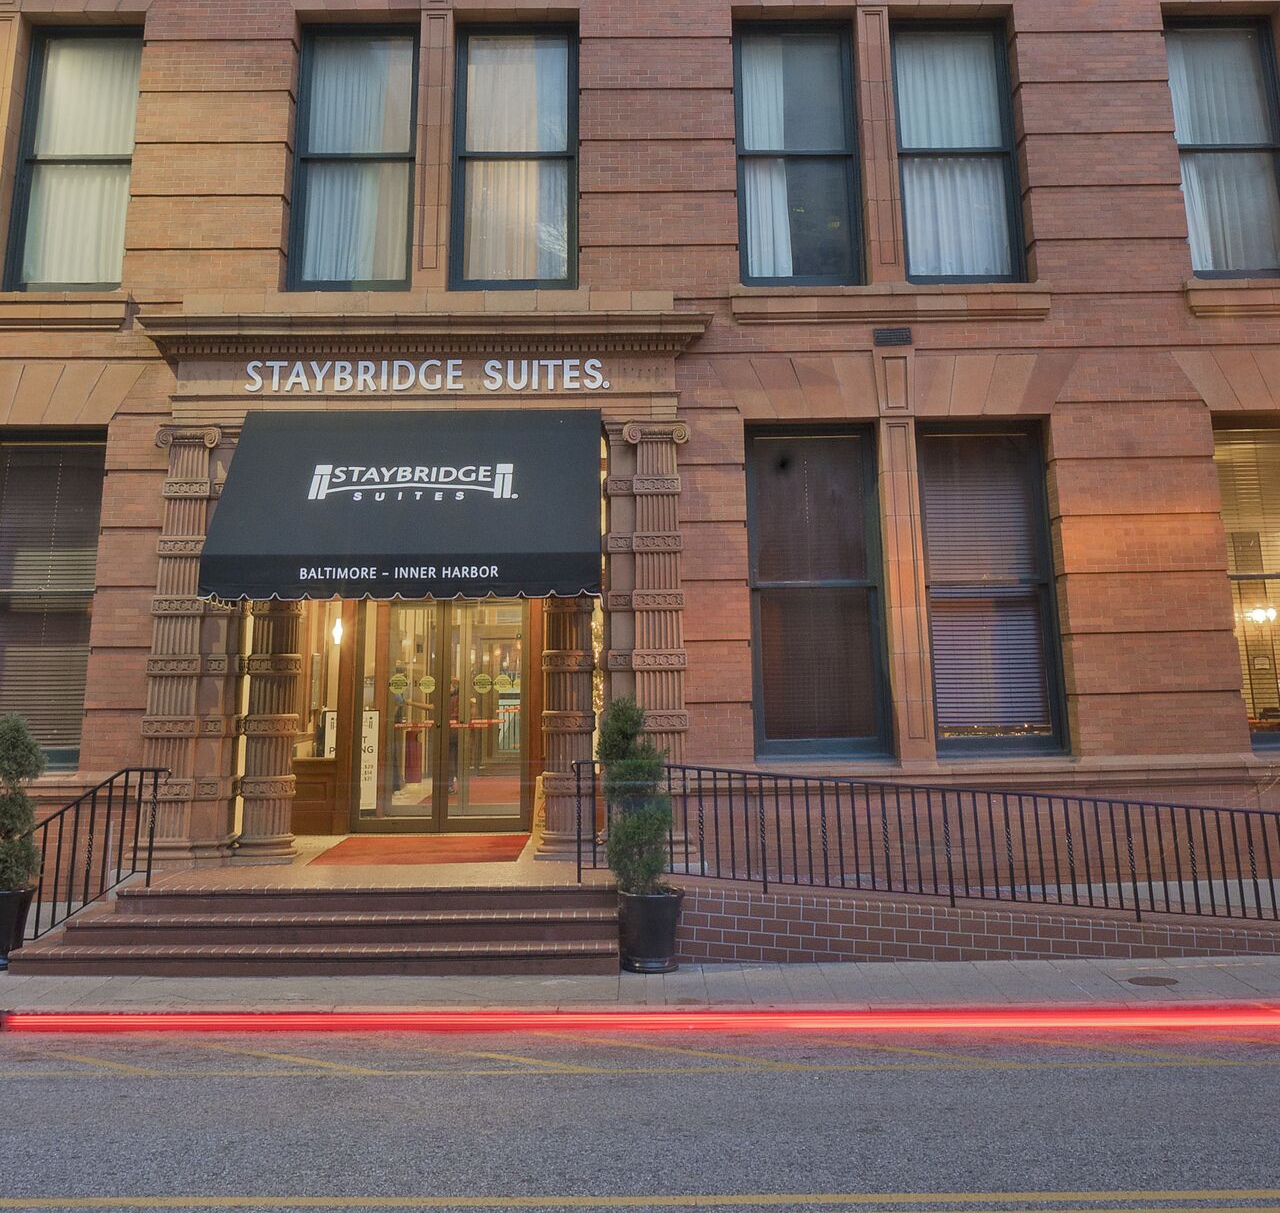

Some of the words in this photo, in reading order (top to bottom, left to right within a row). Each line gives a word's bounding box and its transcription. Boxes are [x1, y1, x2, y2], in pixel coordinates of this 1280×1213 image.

[244, 359, 463, 392] STAYBRIDGE
[331, 465, 492, 483] STAYBRIDGE
[352, 491, 466, 501] SUITES
[299, 567, 377, 579] BALTIMORE
[394, 566, 436, 579] INNER
[442, 565, 499, 578] HARBOR
